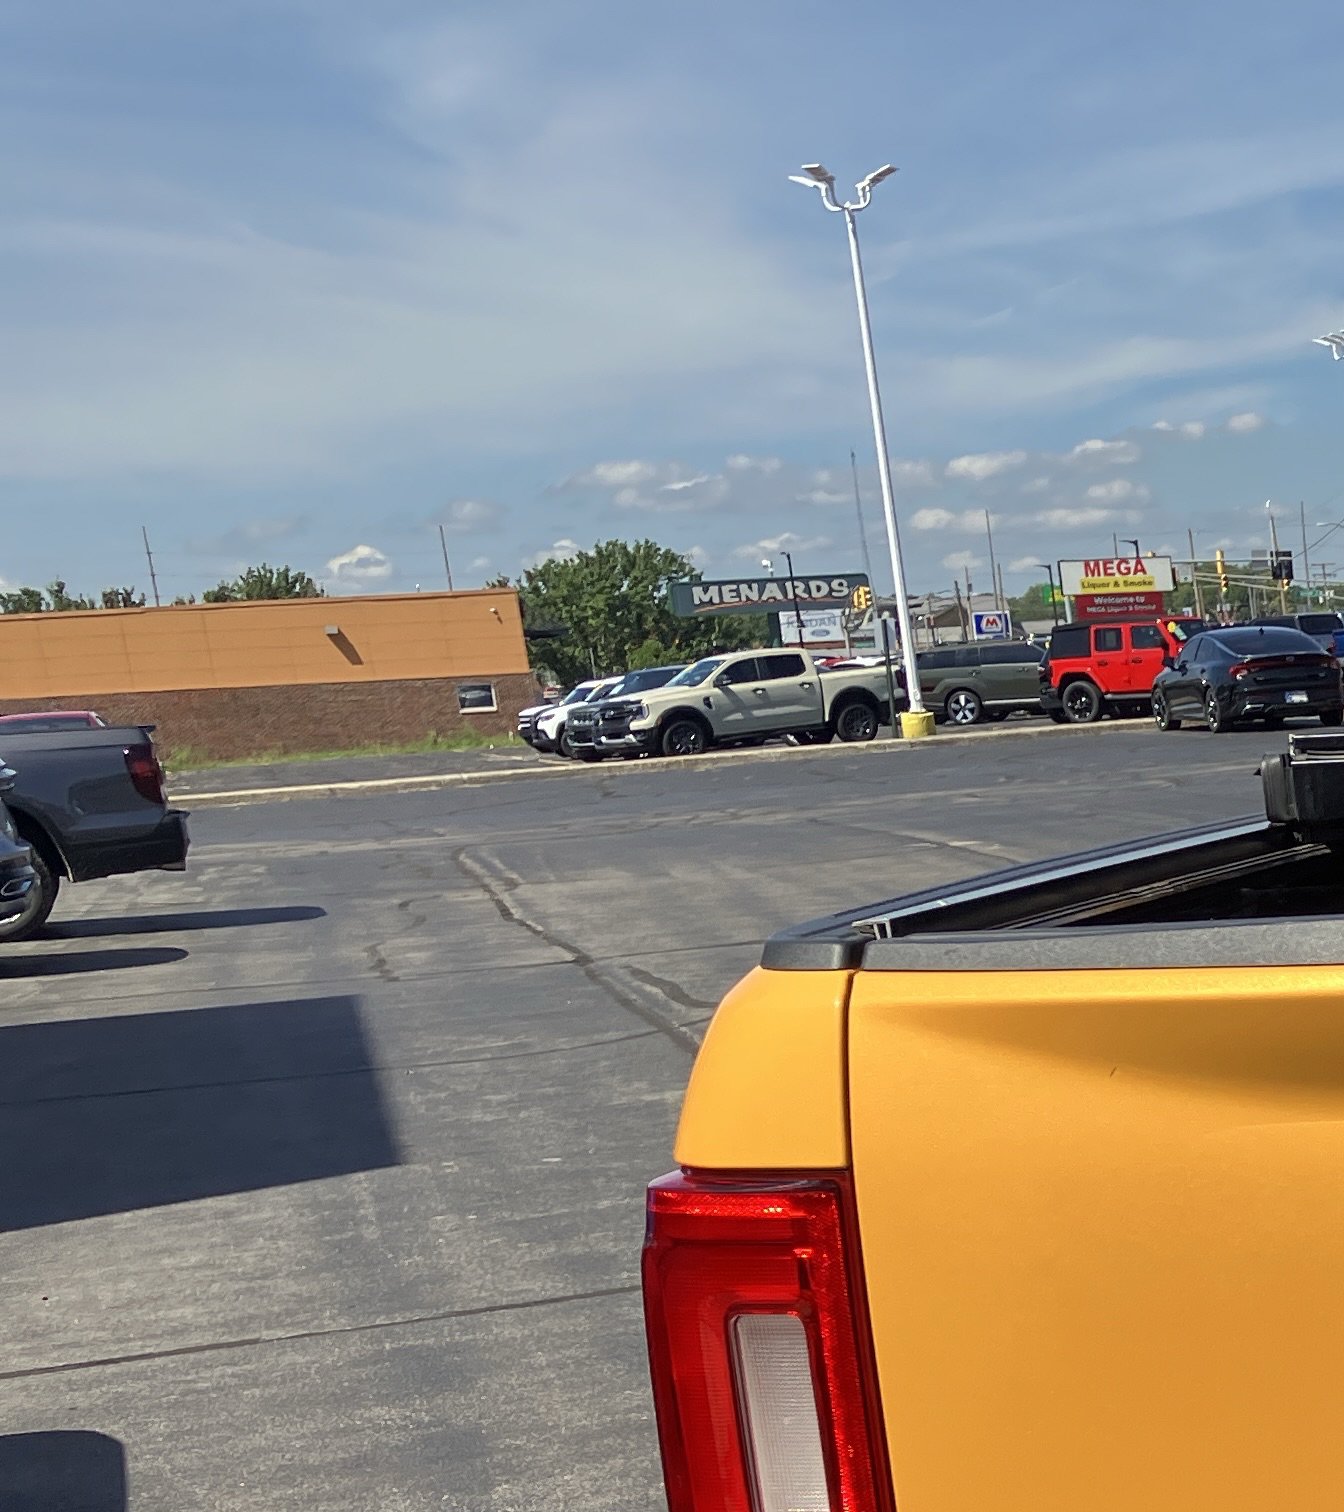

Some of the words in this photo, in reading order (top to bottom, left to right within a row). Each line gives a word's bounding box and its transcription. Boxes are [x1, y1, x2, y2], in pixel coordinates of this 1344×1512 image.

[1084, 558, 1148, 577] MEGA
[692, 578, 849, 605] MENARDS
[1081, 581, 1110, 590] Liquor
[985, 618, 998, 627] M
